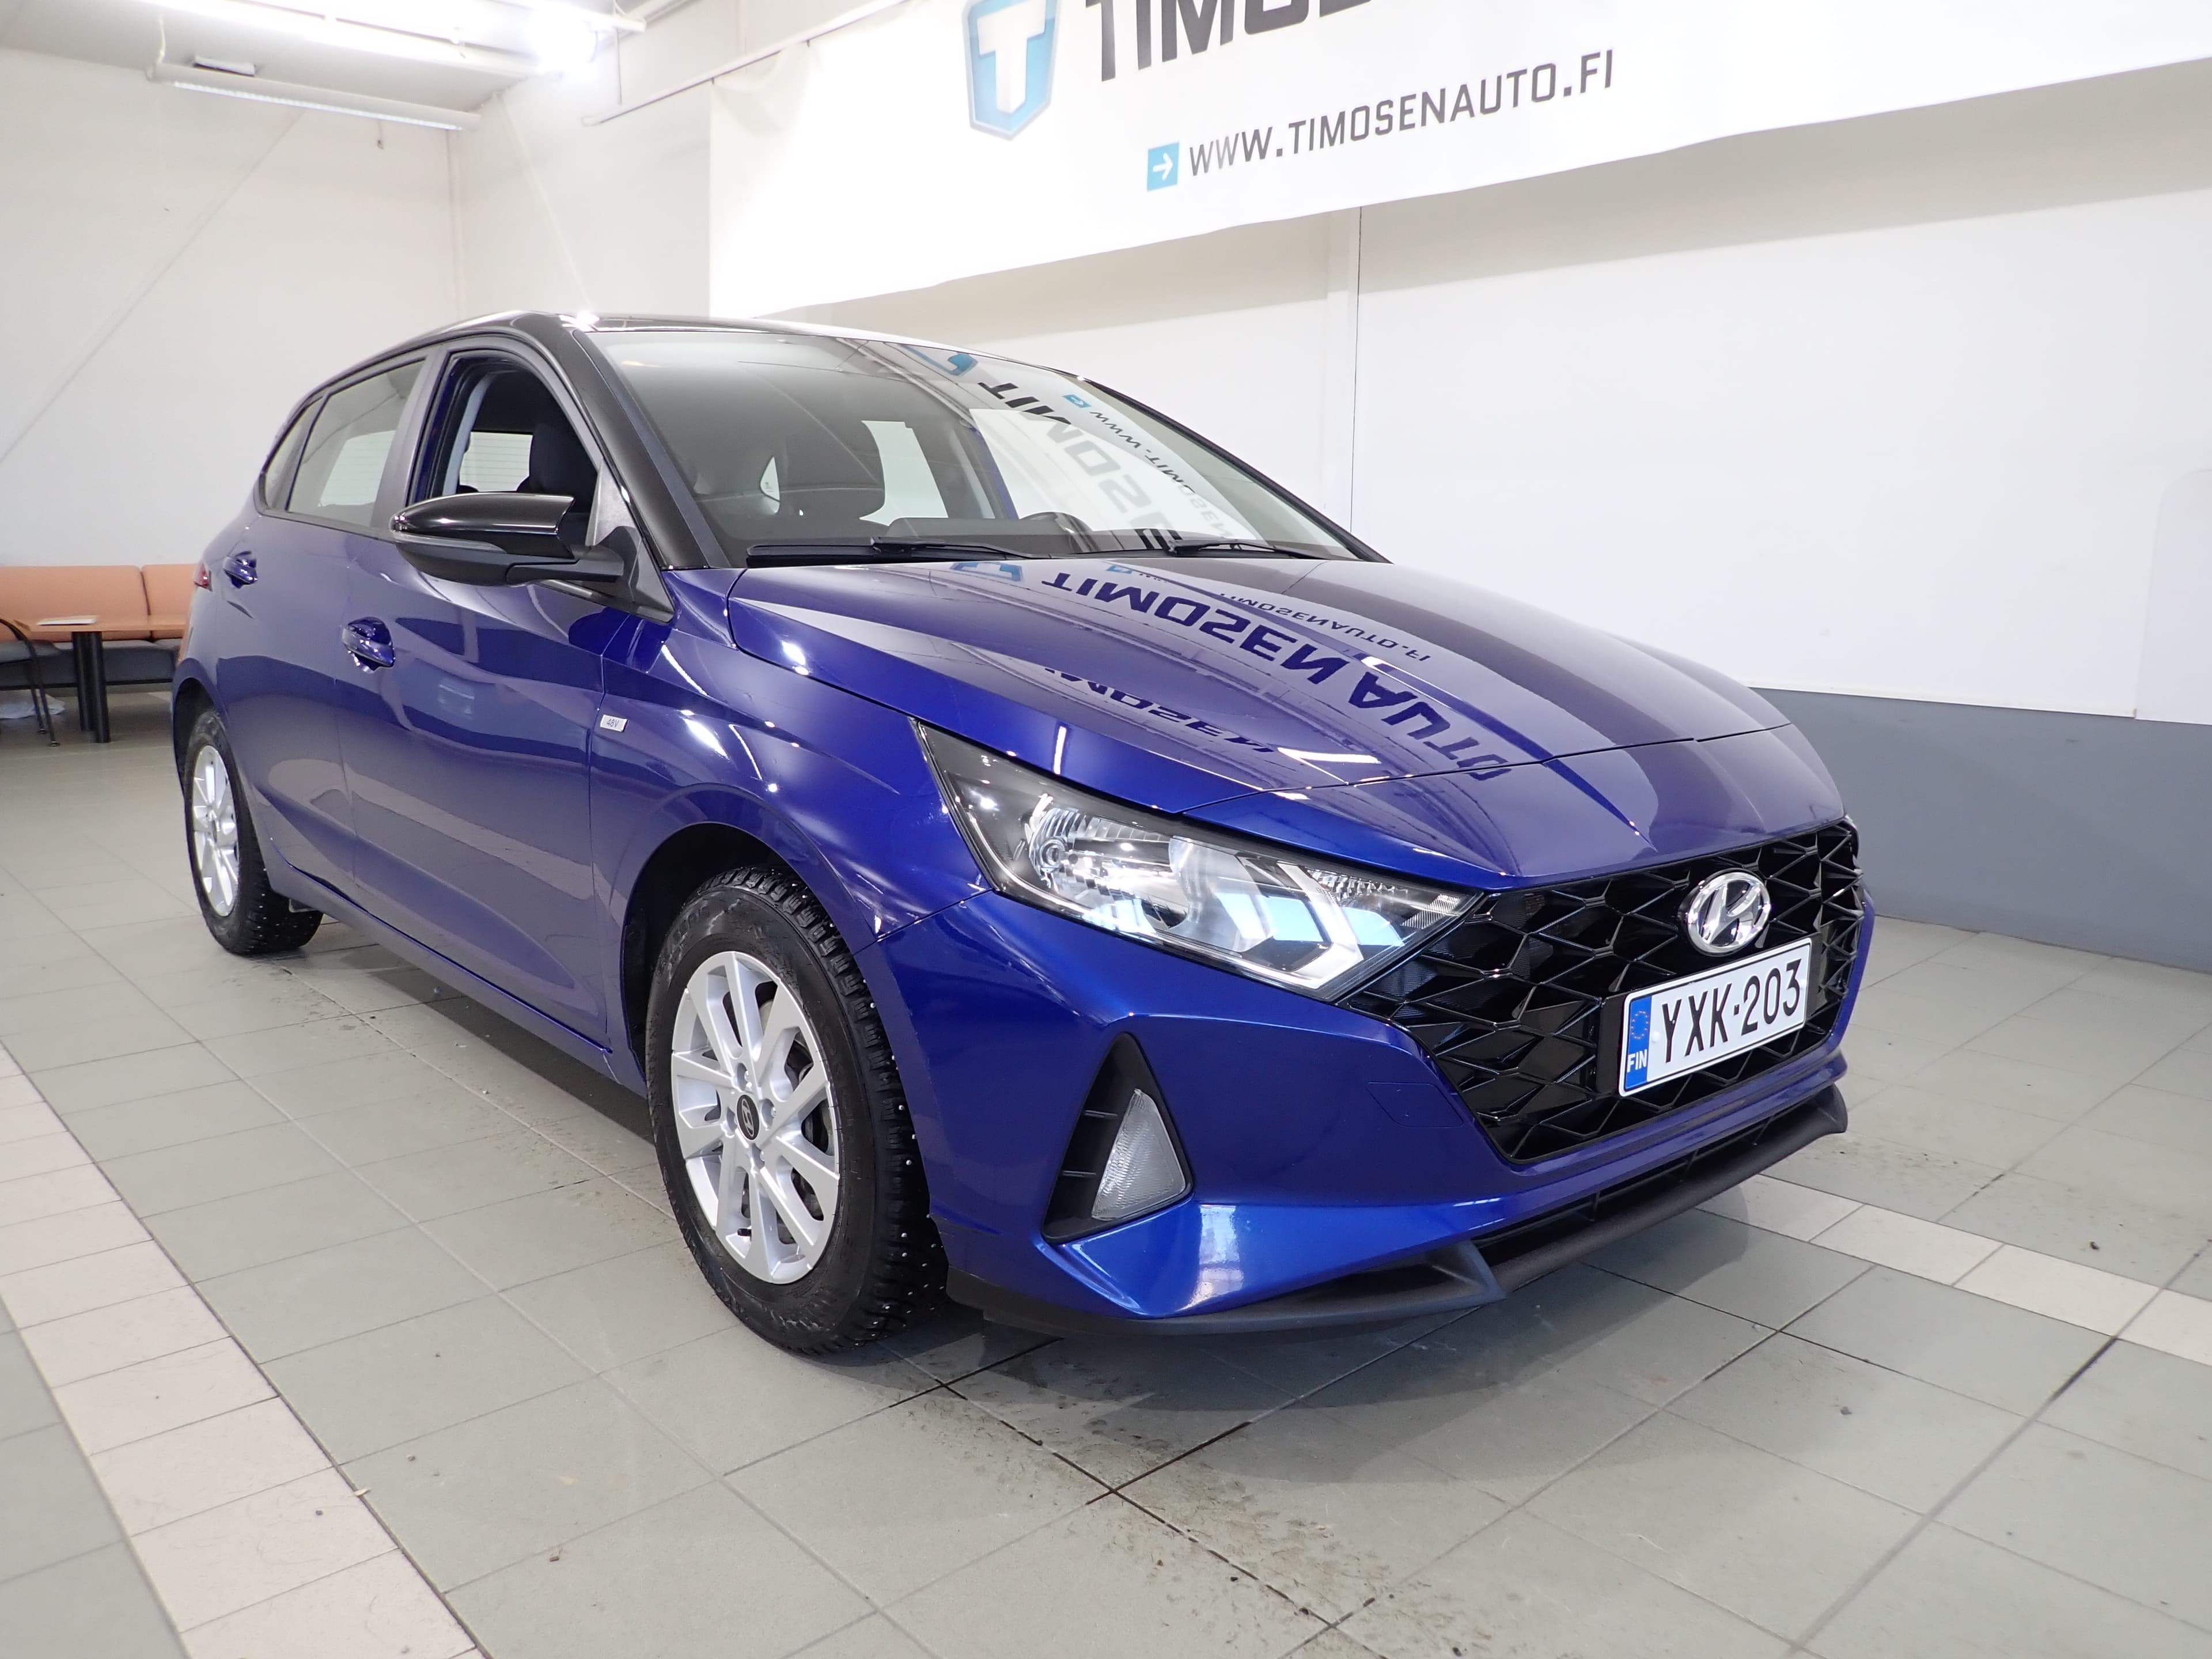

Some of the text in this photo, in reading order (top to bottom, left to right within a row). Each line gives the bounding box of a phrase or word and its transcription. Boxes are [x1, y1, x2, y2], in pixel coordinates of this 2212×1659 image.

[1085, 0, 1372, 82] TIM
[1189, 48, 1613, 177] WWW.TIMOSENAUTO.FI
[1661, 958, 1802, 1065] YXK-203
[1627, 1048, 1647, 1073] FIN
